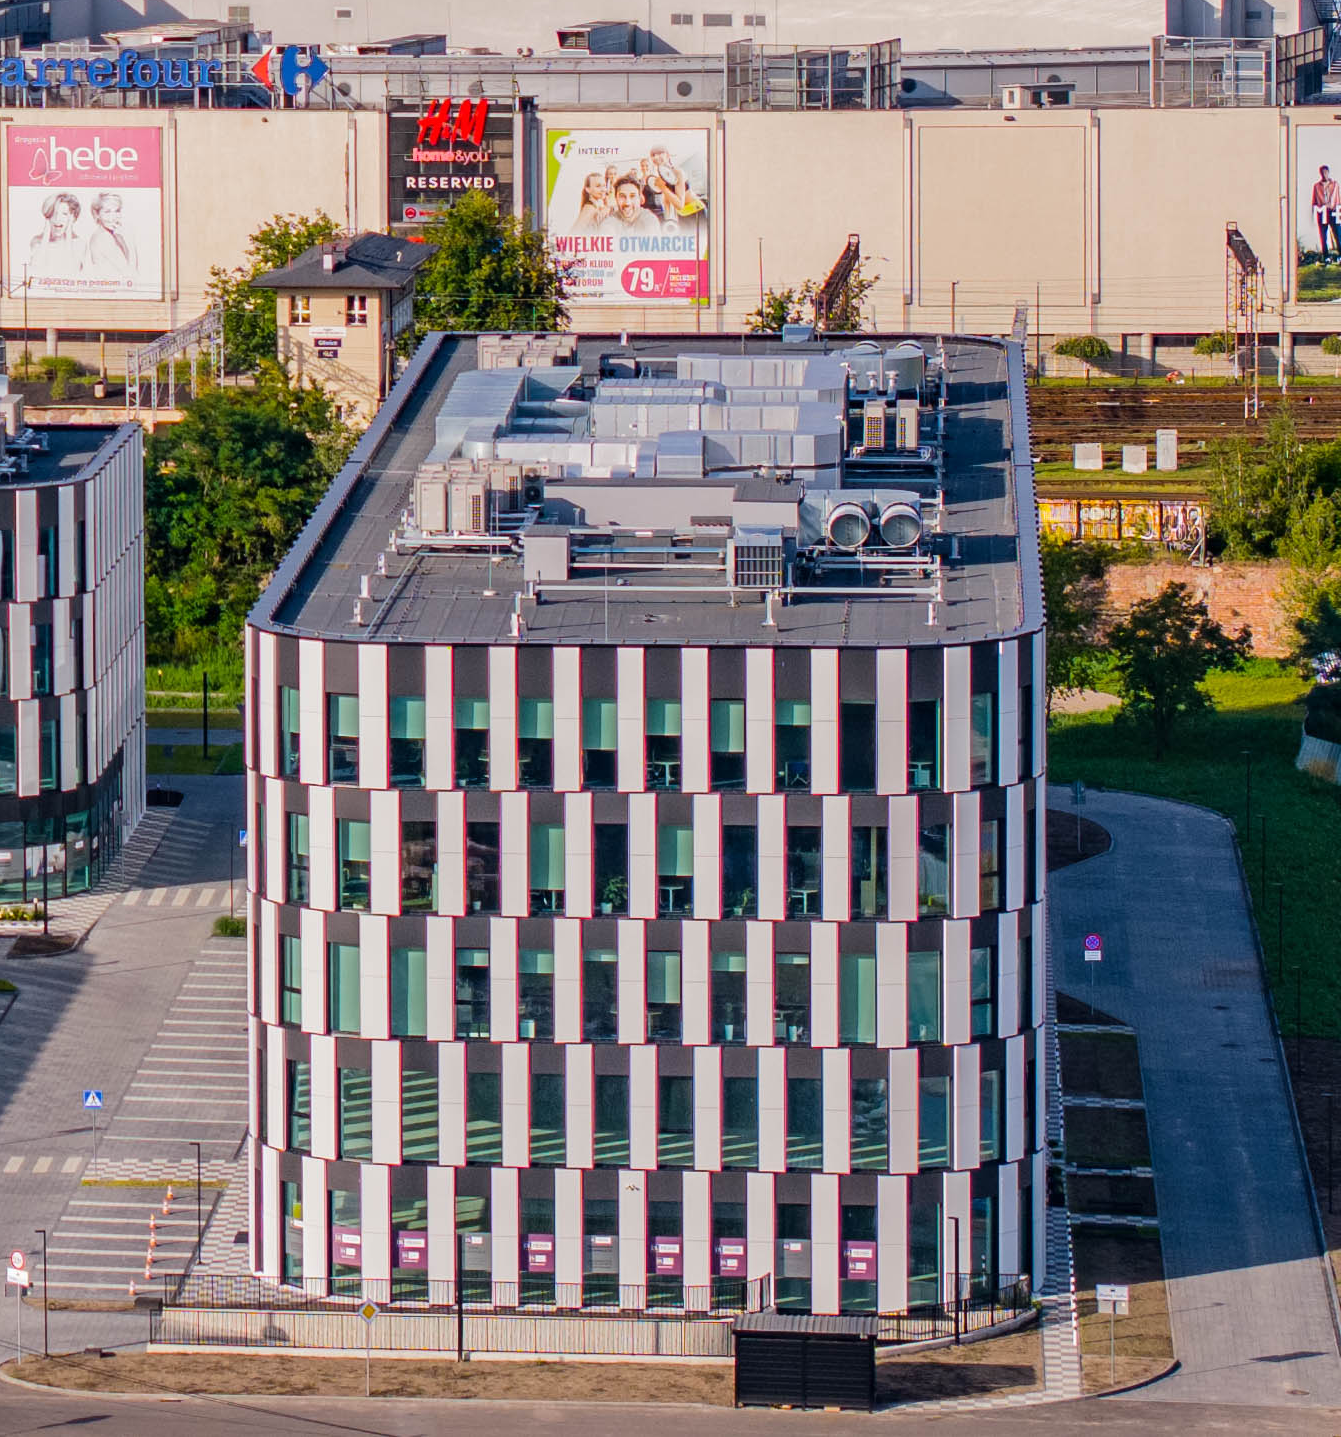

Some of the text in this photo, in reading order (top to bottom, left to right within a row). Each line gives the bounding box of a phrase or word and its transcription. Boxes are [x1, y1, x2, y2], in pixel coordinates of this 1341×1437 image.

[417, 97, 489, 146] H&M
[49, 135, 139, 171] hebe
[412, 147, 493, 165] home&you
[578, 147, 620, 155] INTERFIT
[405, 176, 495, 190] RESERVED
[555, 236, 696, 253] WIELKIE OTWARCIE
[627, 267, 654, 292] 79
